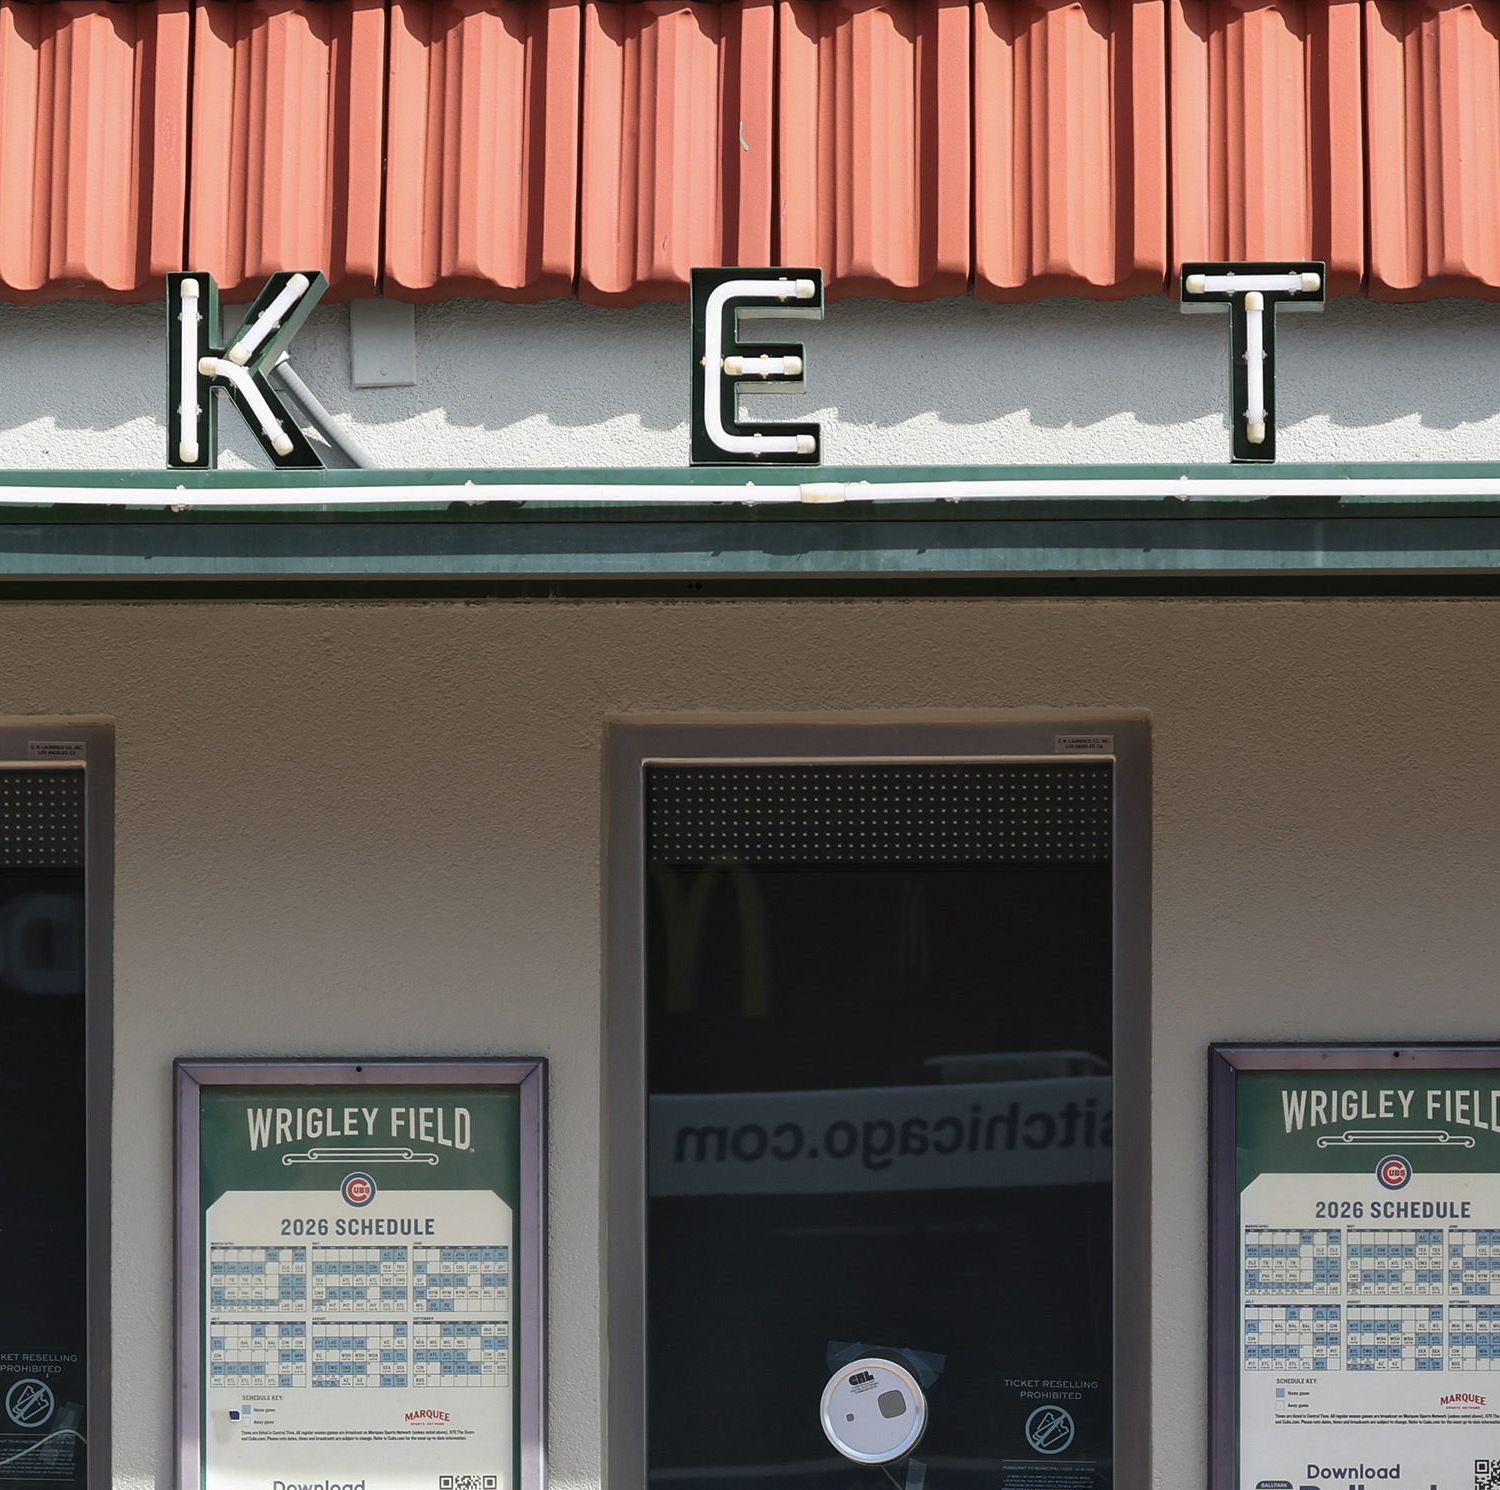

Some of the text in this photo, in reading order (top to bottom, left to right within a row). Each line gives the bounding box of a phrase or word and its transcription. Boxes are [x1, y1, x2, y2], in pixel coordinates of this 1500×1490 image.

[1281, 1090, 1415, 1134] WRIGLEY
[247, 1107, 471, 1152] WRIGLEY FIELD
[1316, 1202, 1470, 1218] 2026 SCHEDULE
[281, 1219, 434, 1235] 2026 SCHEDULE
[22, 1353, 78, 1362] RESELLING
[0, 1365, 62, 1373] PROHIBITED
[1004, 1379, 1098, 1389] TICKET RESELLING
[1020, 1391, 1082, 1400] PROHIBITED
[1440, 1393, 1486, 1406] MARQUEE
[404, 1409, 451, 1422] MARQUEE
[1308, 1464, 1400, 1479] Download
